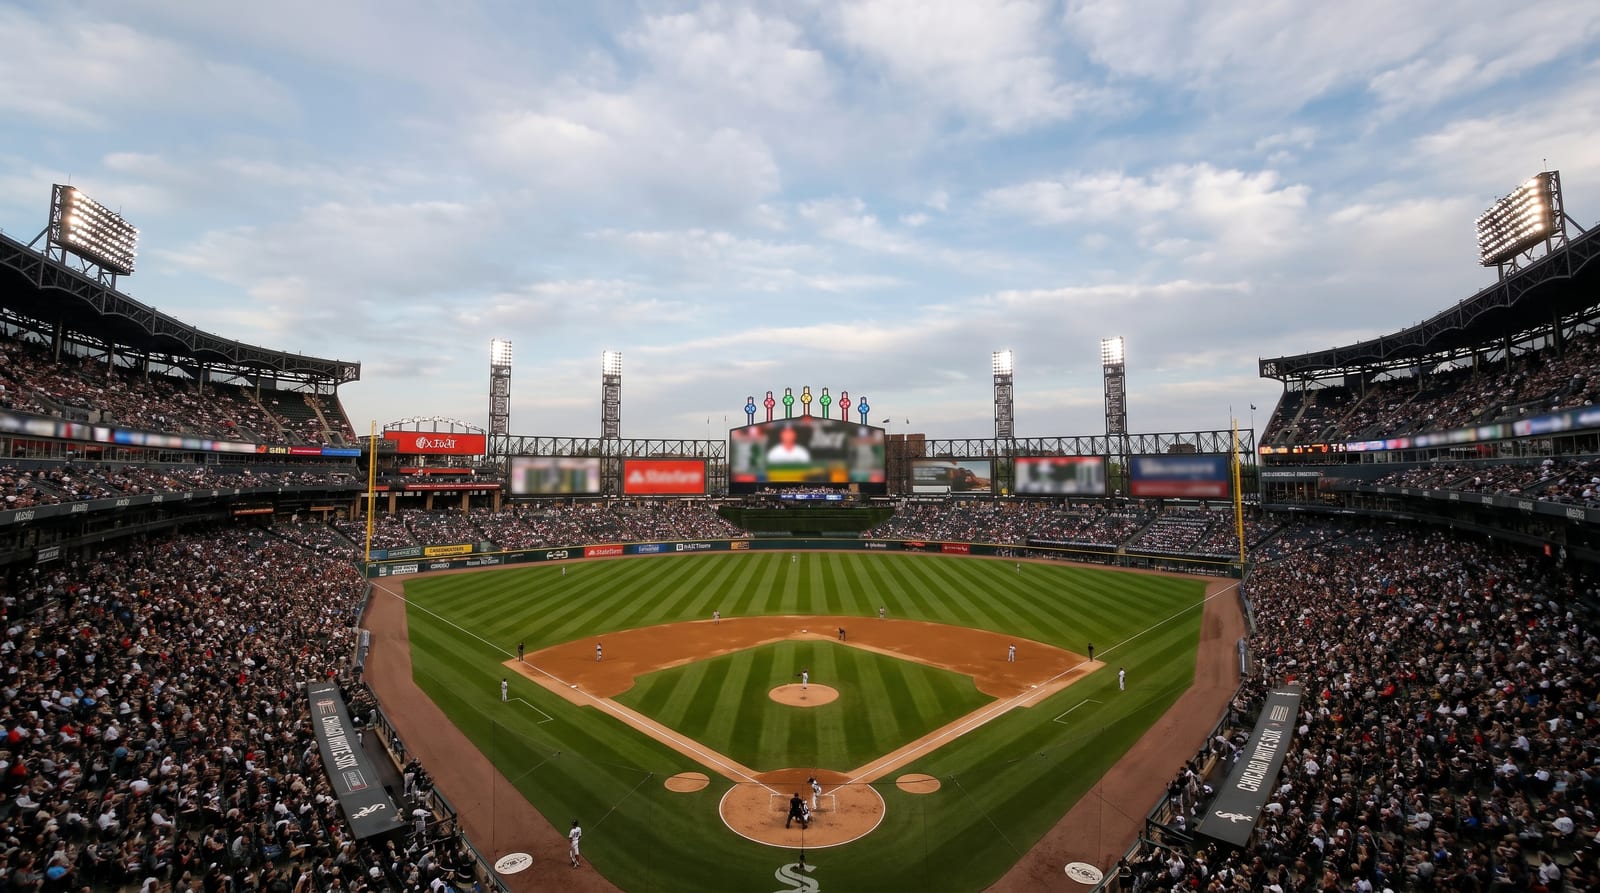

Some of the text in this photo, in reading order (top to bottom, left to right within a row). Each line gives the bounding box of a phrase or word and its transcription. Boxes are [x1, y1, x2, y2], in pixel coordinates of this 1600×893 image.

[328, 735, 352, 757] WHITE
[334, 754, 359, 770] SOX
[1237, 728, 1283, 792] CHICAGO WHITE SOX
